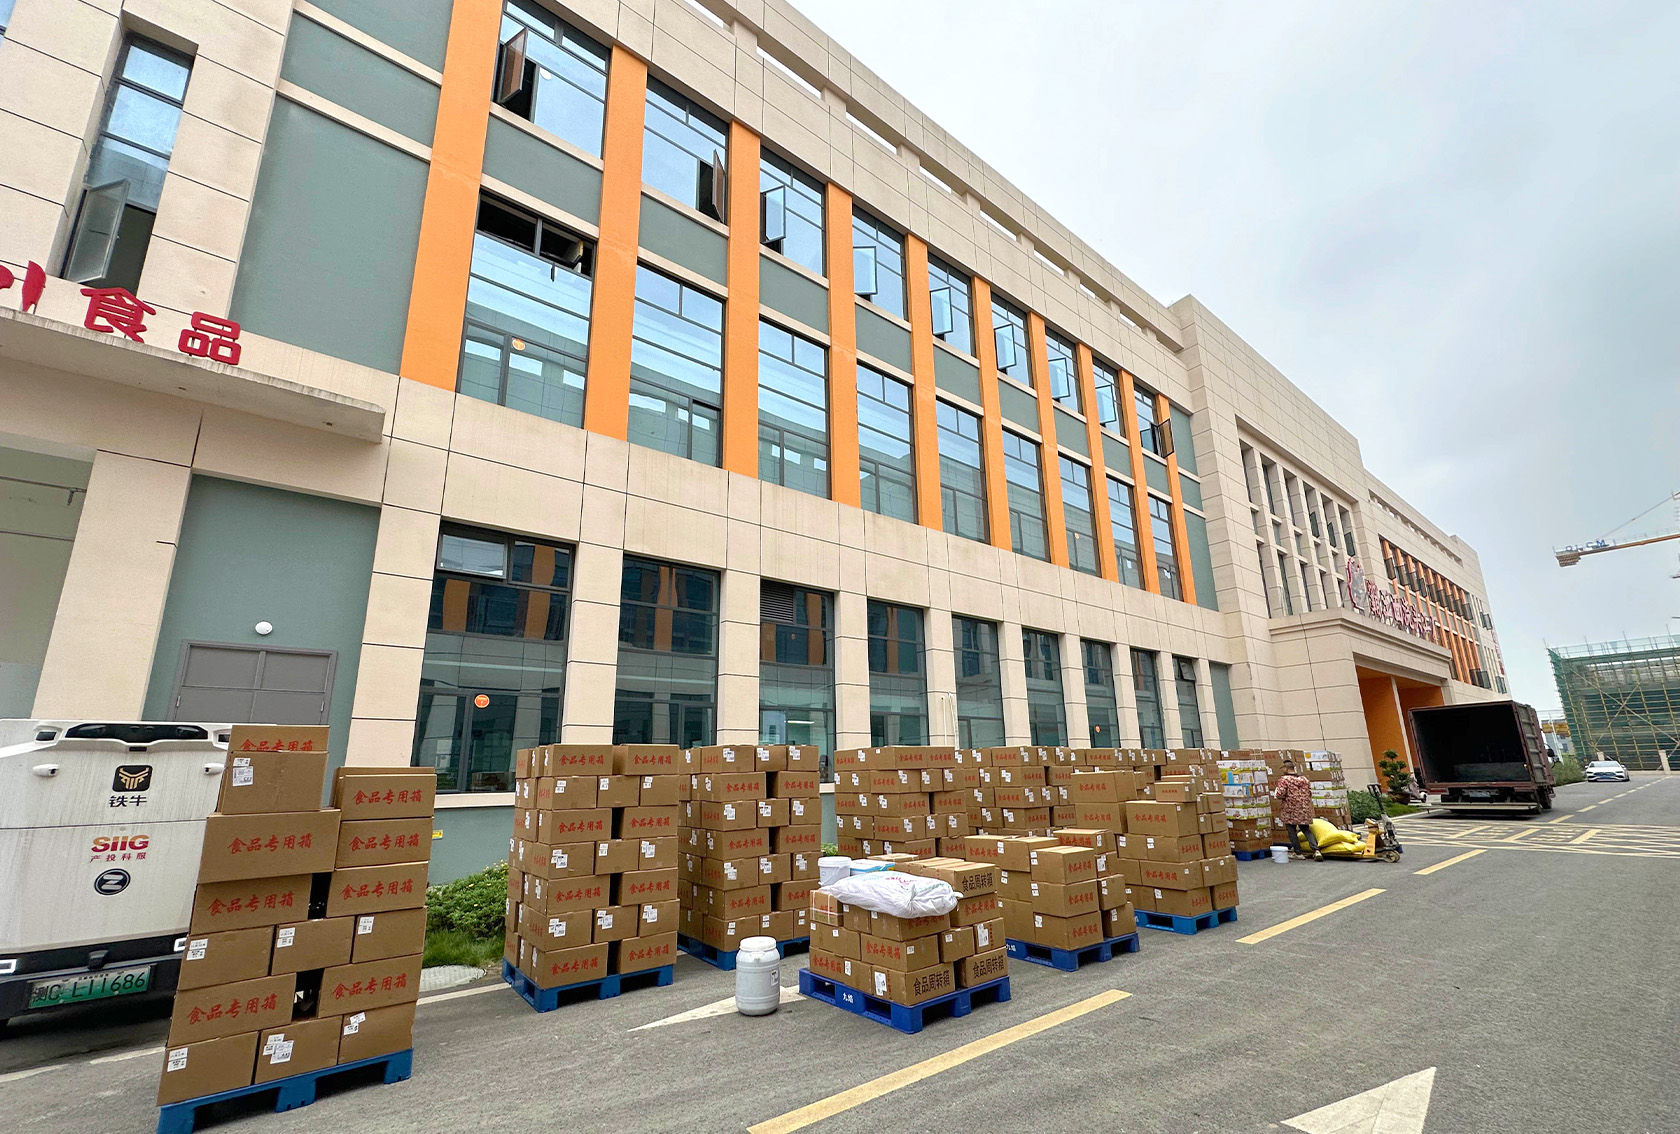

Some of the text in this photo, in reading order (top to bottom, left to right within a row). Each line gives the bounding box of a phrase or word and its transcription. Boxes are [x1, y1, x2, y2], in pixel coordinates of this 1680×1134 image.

[560, 755, 603, 766] 食品专用箱
[634, 755, 671, 765] 食品专用箱
[899, 754, 922, 762] 食品专用箱
[725, 782, 759, 793] 食品专用箱
[783, 781, 814, 790] 食品专用箱
[1079, 784, 1106, 792] 食品专用箱
[109, 795, 147, 807] 铁牛
[354, 789, 421, 806] 食品专用箱
[631, 816, 669, 828] 食品专用箱
[1083, 814, 1111, 822] 食品专用箱
[1134, 814, 1166, 823] 食品专用箱
[558, 820, 602, 834] 食品专用箱
[877, 826, 899, 834] 食品专用箱
[91, 834, 149, 852] SIIG
[228, 833, 312, 855] 食品专用箱
[349, 833, 419, 852] 食品专用箱
[728, 838, 762, 849] 食品专用箱
[784, 834, 815, 844] 食品专用箱
[1058, 836, 1092, 847] 食品专用箱
[89, 852, 147, 863] 产投科服
[1067, 861, 1091, 873] 食品专用箱
[961, 872, 993, 893] 食品周转箱
[1144, 870, 1177, 881] 食品专用箱
[341, 879, 412, 901] 食品专用箱
[555, 887, 600, 902] 食品专用箱
[629, 880, 670, 895] 食品专用箱
[208, 891, 293, 917] 食品专用箱
[730, 896, 764, 910] 食品专用箱
[1067, 893, 1094, 905] 食品专用箱
[964, 899, 995, 916] 食品专用箱
[1072, 925, 1098, 937] 食品专用箱
[629, 944, 669, 961] 食品专用箱
[865, 942, 900, 960] 食品专用箱
[551, 957, 598, 976] 食品专用箱
[812, 955, 841, 974] 食品专用箱
[973, 954, 1004, 979] 食品周转箱
[72, 971, 145, 998] L11686
[332, 973, 406, 1000] 食品专用箱
[913, 969, 951, 998] 食品周转箱
[187, 993, 277, 1026] 食品专用箱
